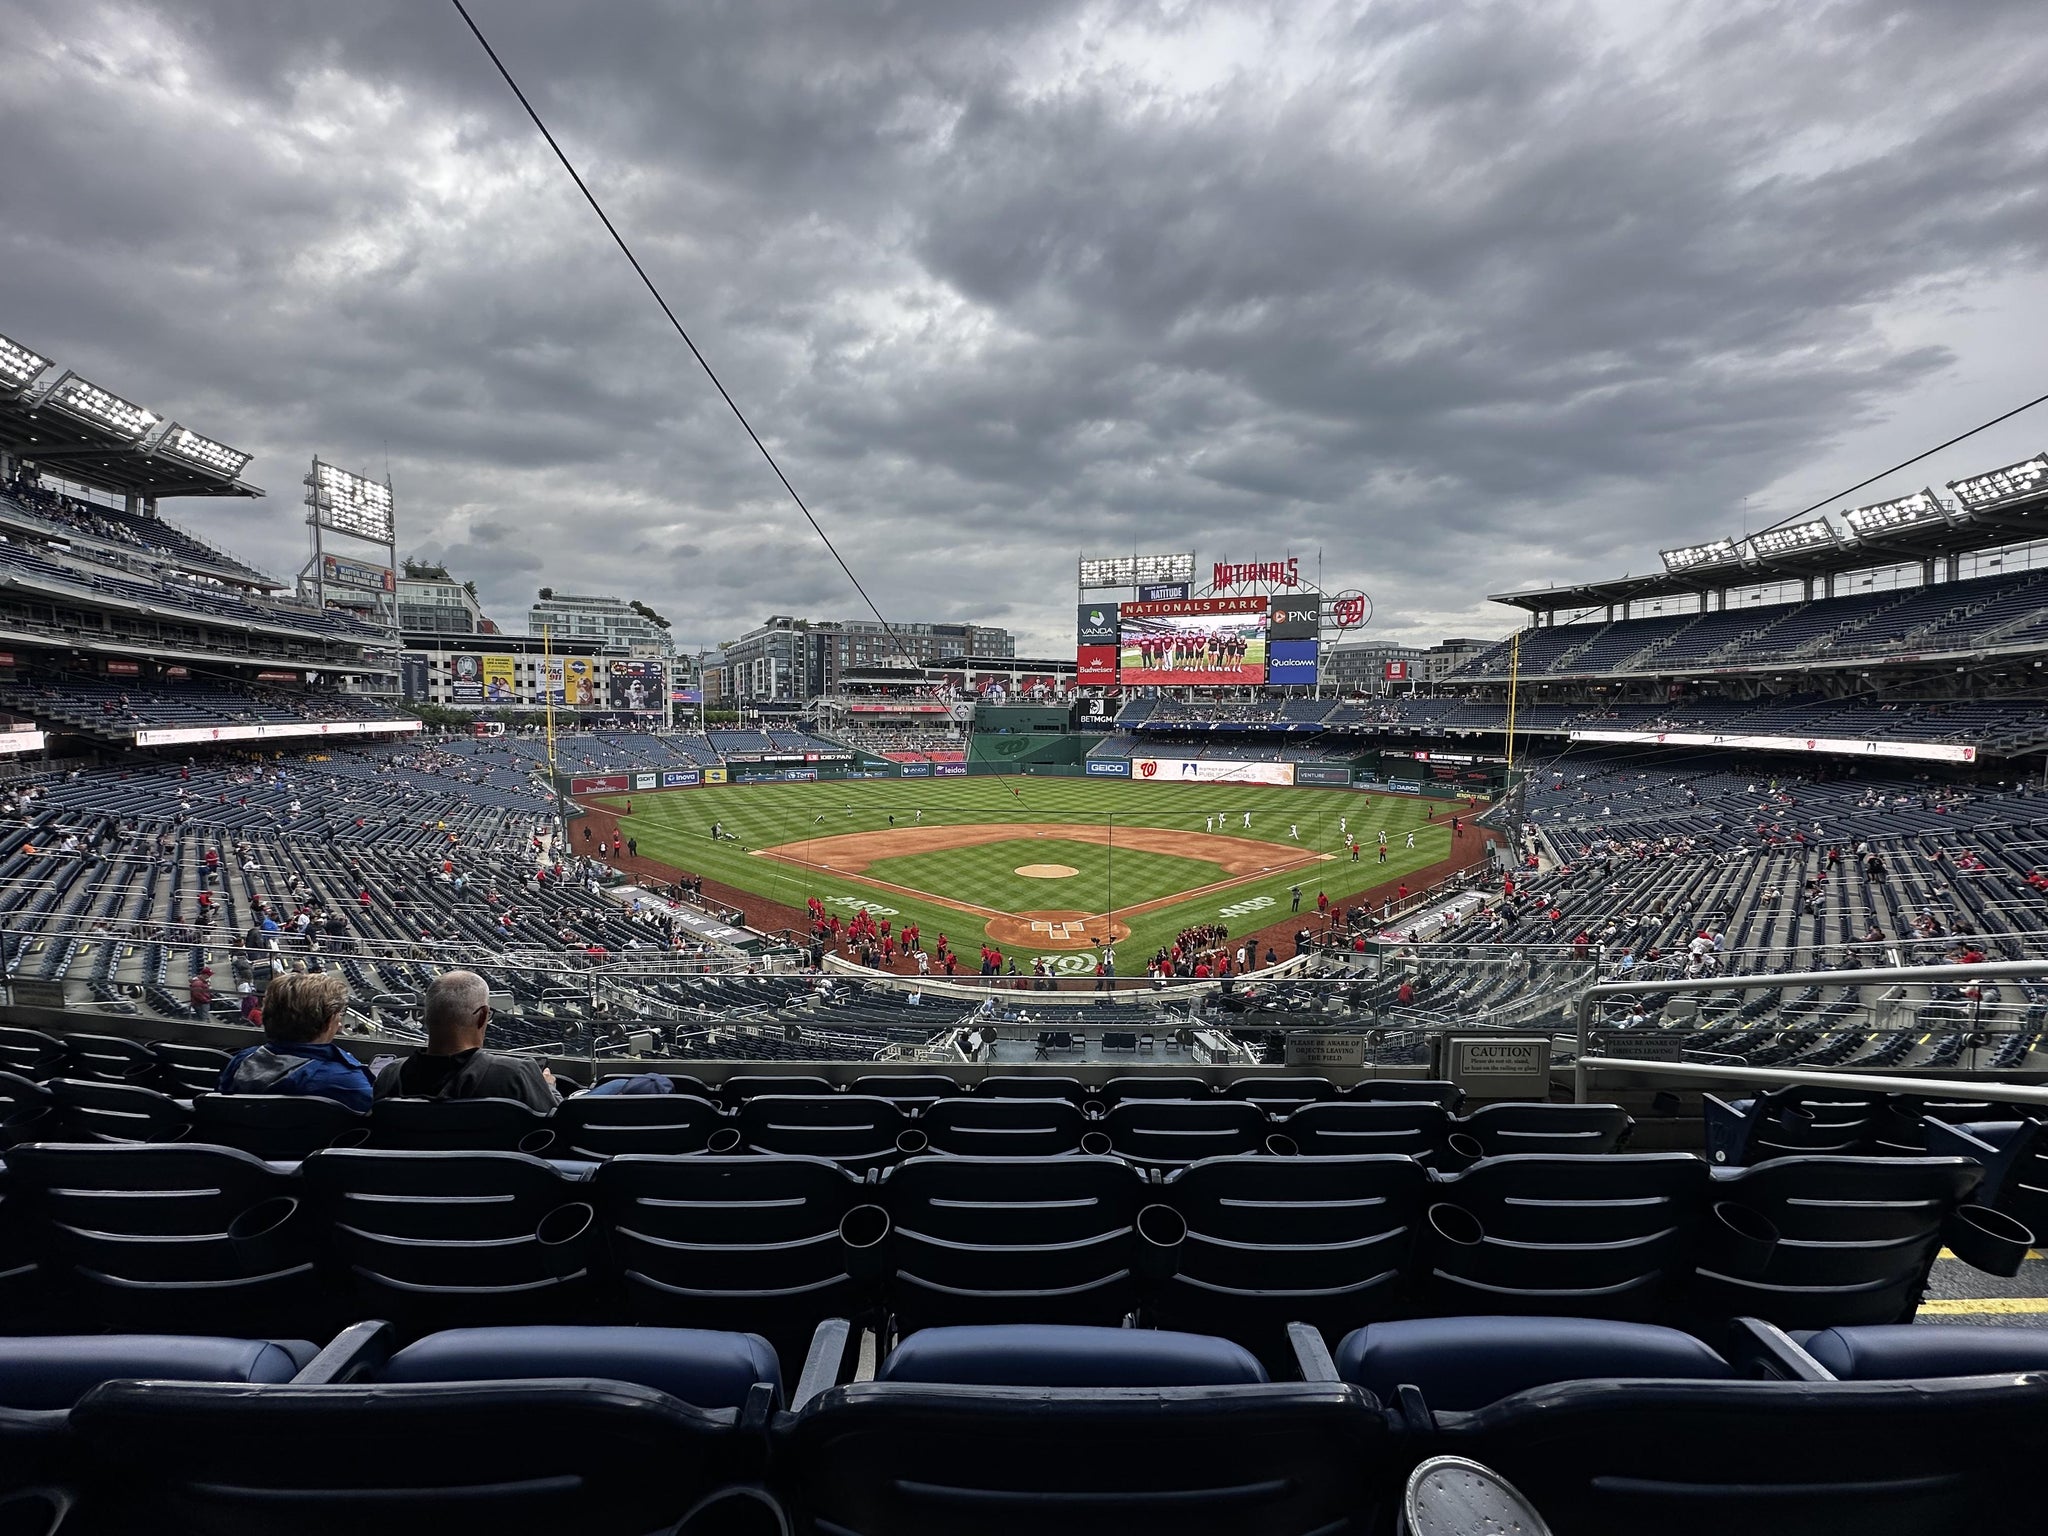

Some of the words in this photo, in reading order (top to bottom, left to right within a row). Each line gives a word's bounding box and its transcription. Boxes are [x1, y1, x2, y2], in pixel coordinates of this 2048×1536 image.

[1214, 558, 1298, 590] NATIONALS
[1151, 587, 1182, 600] NATITUDE
[1126, 602, 1210, 614] NATIONALS
[1219, 600, 1258, 610] PARK
[1288, 610, 1317, 622] PNC
[1081, 627, 1113, 635] VANDA
[1271, 658, 1315, 668] Qualcomm
[945, 765, 966, 774] leidos
[1091, 764, 1124, 772] GEICO
[1471, 1047, 1532, 1057] CAUTION
